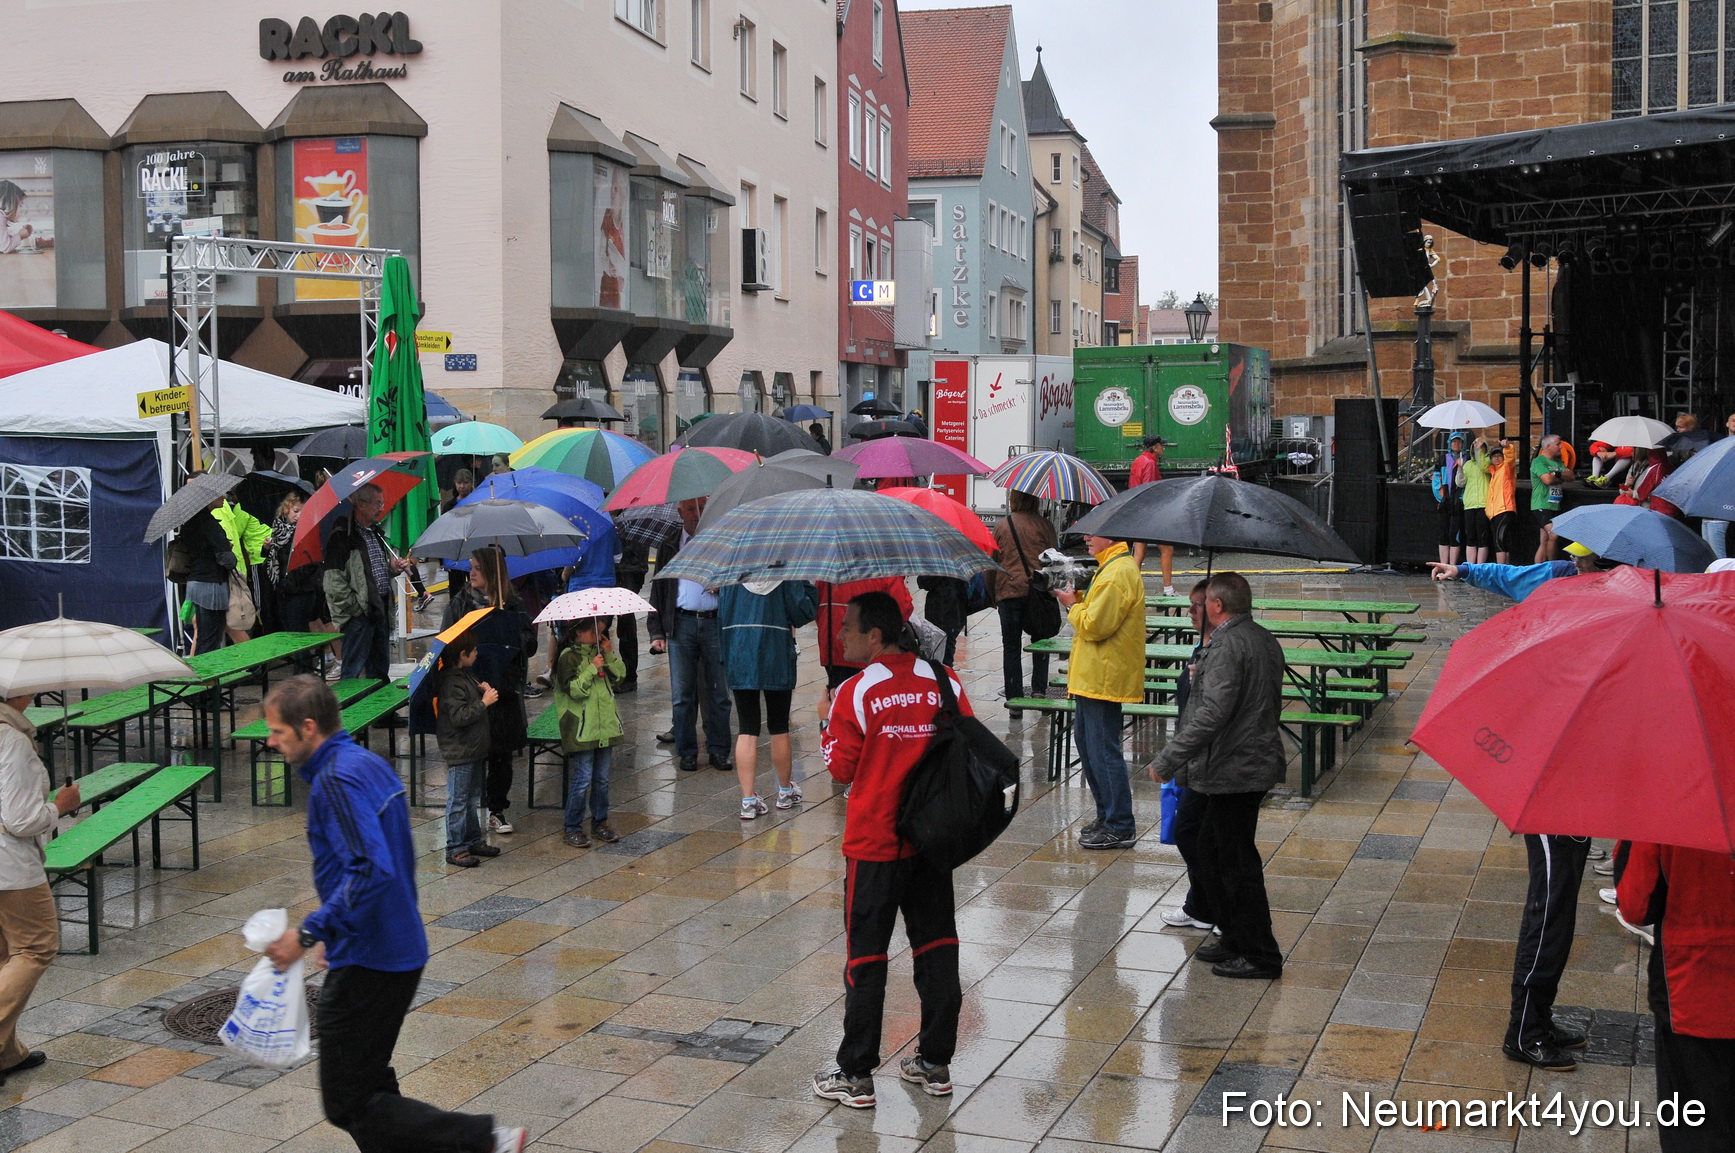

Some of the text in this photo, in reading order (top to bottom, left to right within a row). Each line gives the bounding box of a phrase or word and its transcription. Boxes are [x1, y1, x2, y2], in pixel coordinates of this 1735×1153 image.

[259, 11, 423, 61] RACKL
[282, 58, 408, 83] am Rathaus
[145, 150, 196, 166] 100 Jahre
[141, 166, 188, 191] RACKL
[952, 204, 971, 328] satzke
[154, 390, 186, 402] Kinder-
[338, 384, 364, 400] RACK
[936, 388, 967, 399] Bögerl
[978, 408, 988, 420] Da
[870, 693, 923, 715] Henger
[881, 725, 917, 733] MICHAEL
